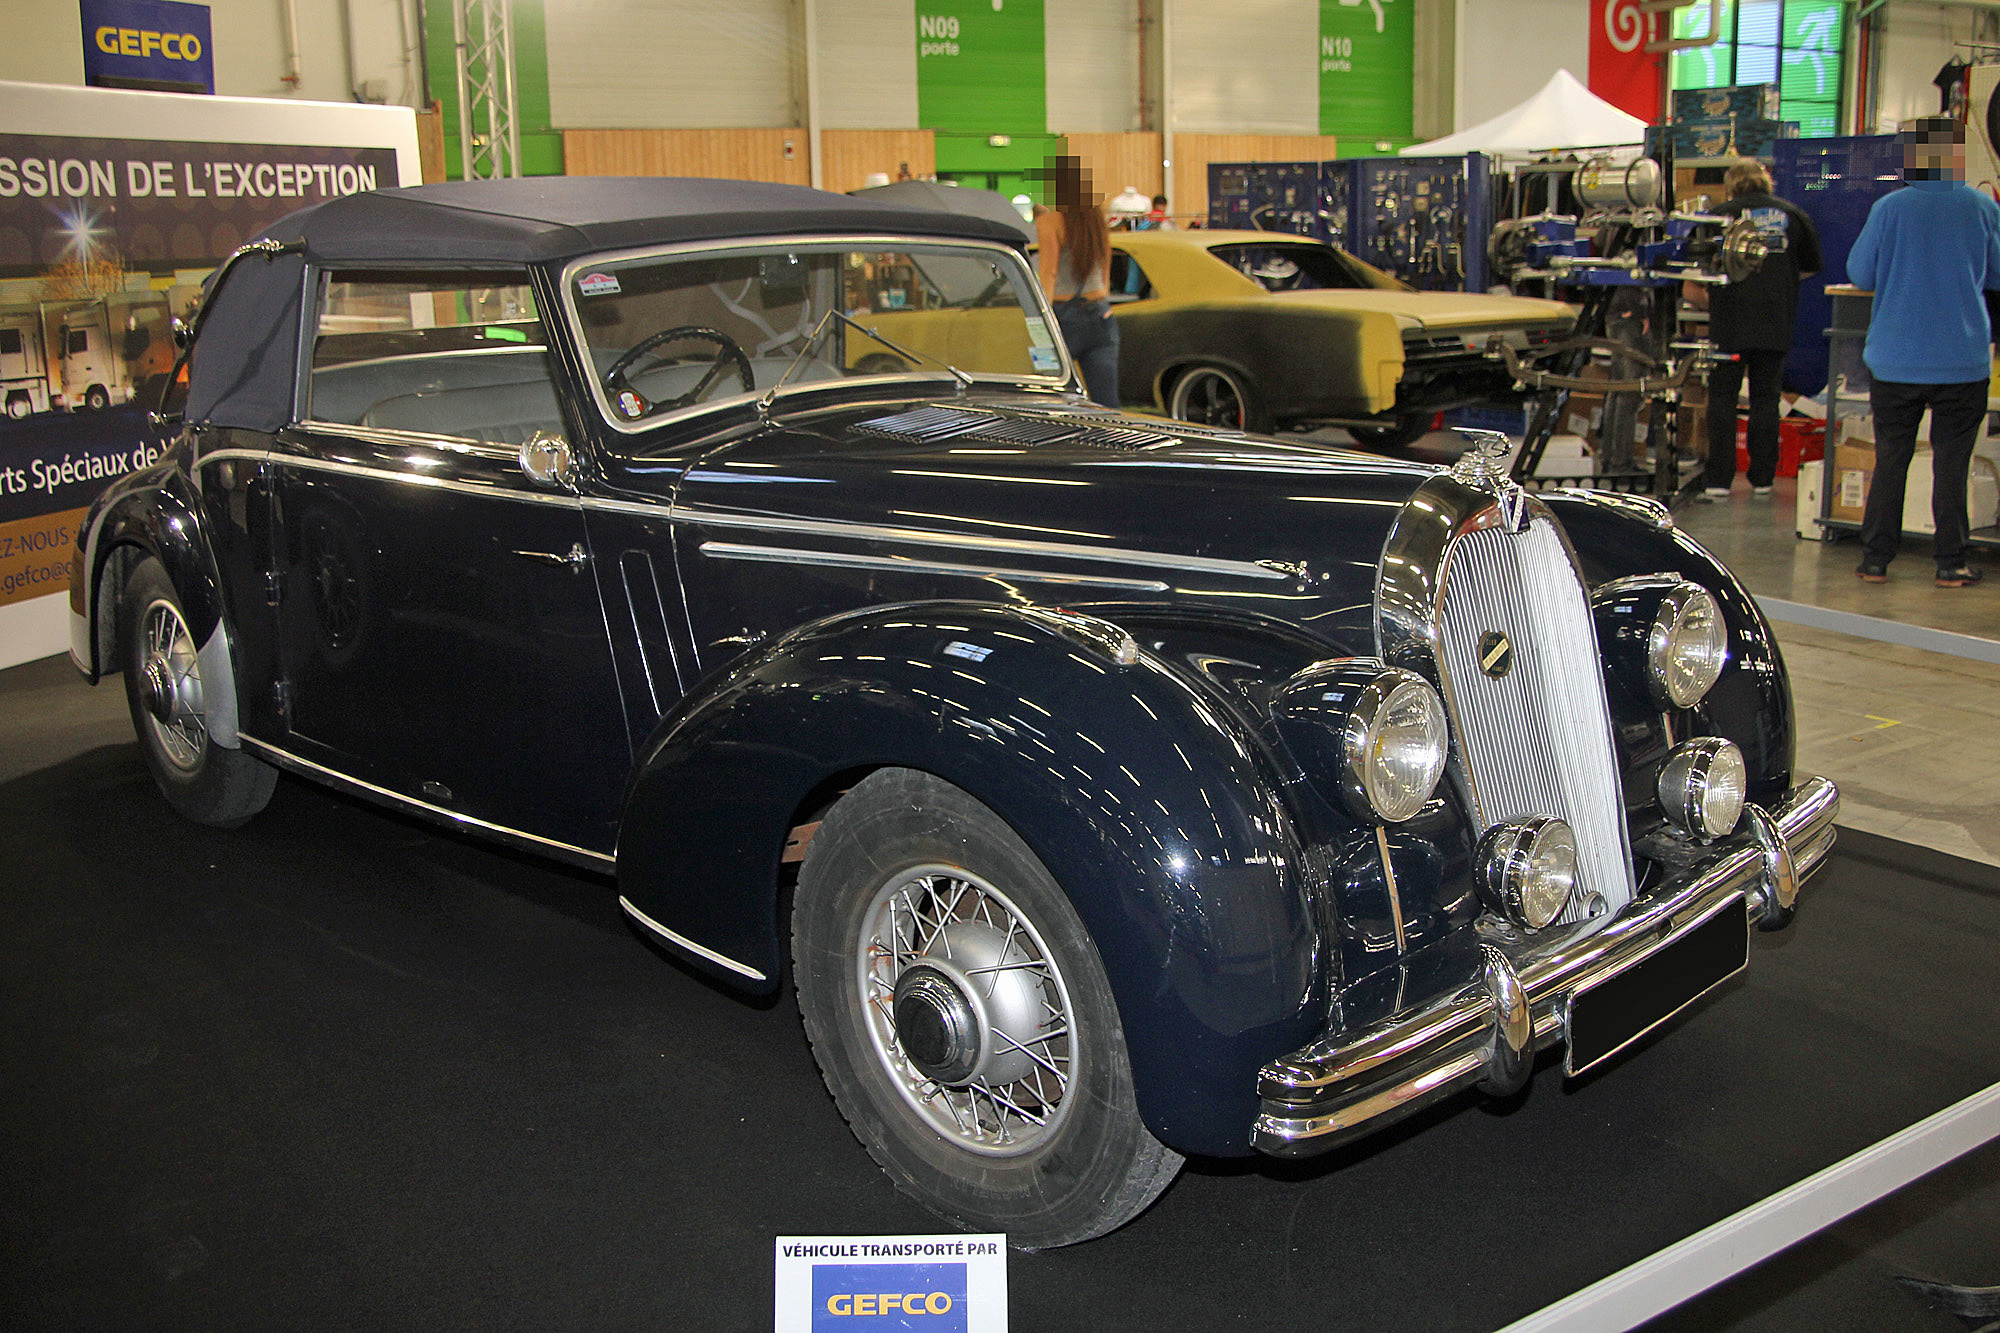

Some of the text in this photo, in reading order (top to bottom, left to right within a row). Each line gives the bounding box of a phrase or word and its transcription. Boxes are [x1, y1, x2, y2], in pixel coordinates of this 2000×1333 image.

[920, 15, 960, 39] N09
[95, 26, 202, 62] GEFCO
[921, 41, 960, 57] porte
[1322, 36, 1352, 57] N10
[0, 157, 117, 198] SSION
[127, 161, 176, 197] DE
[31, 452, 129, 494] Spéciaux
[132, 440, 158, 471] de
[783, 1241, 998, 1257] VÉHICULE TRANSPORTÉ PAR
[826, 1291, 953, 1316] GEFCO
